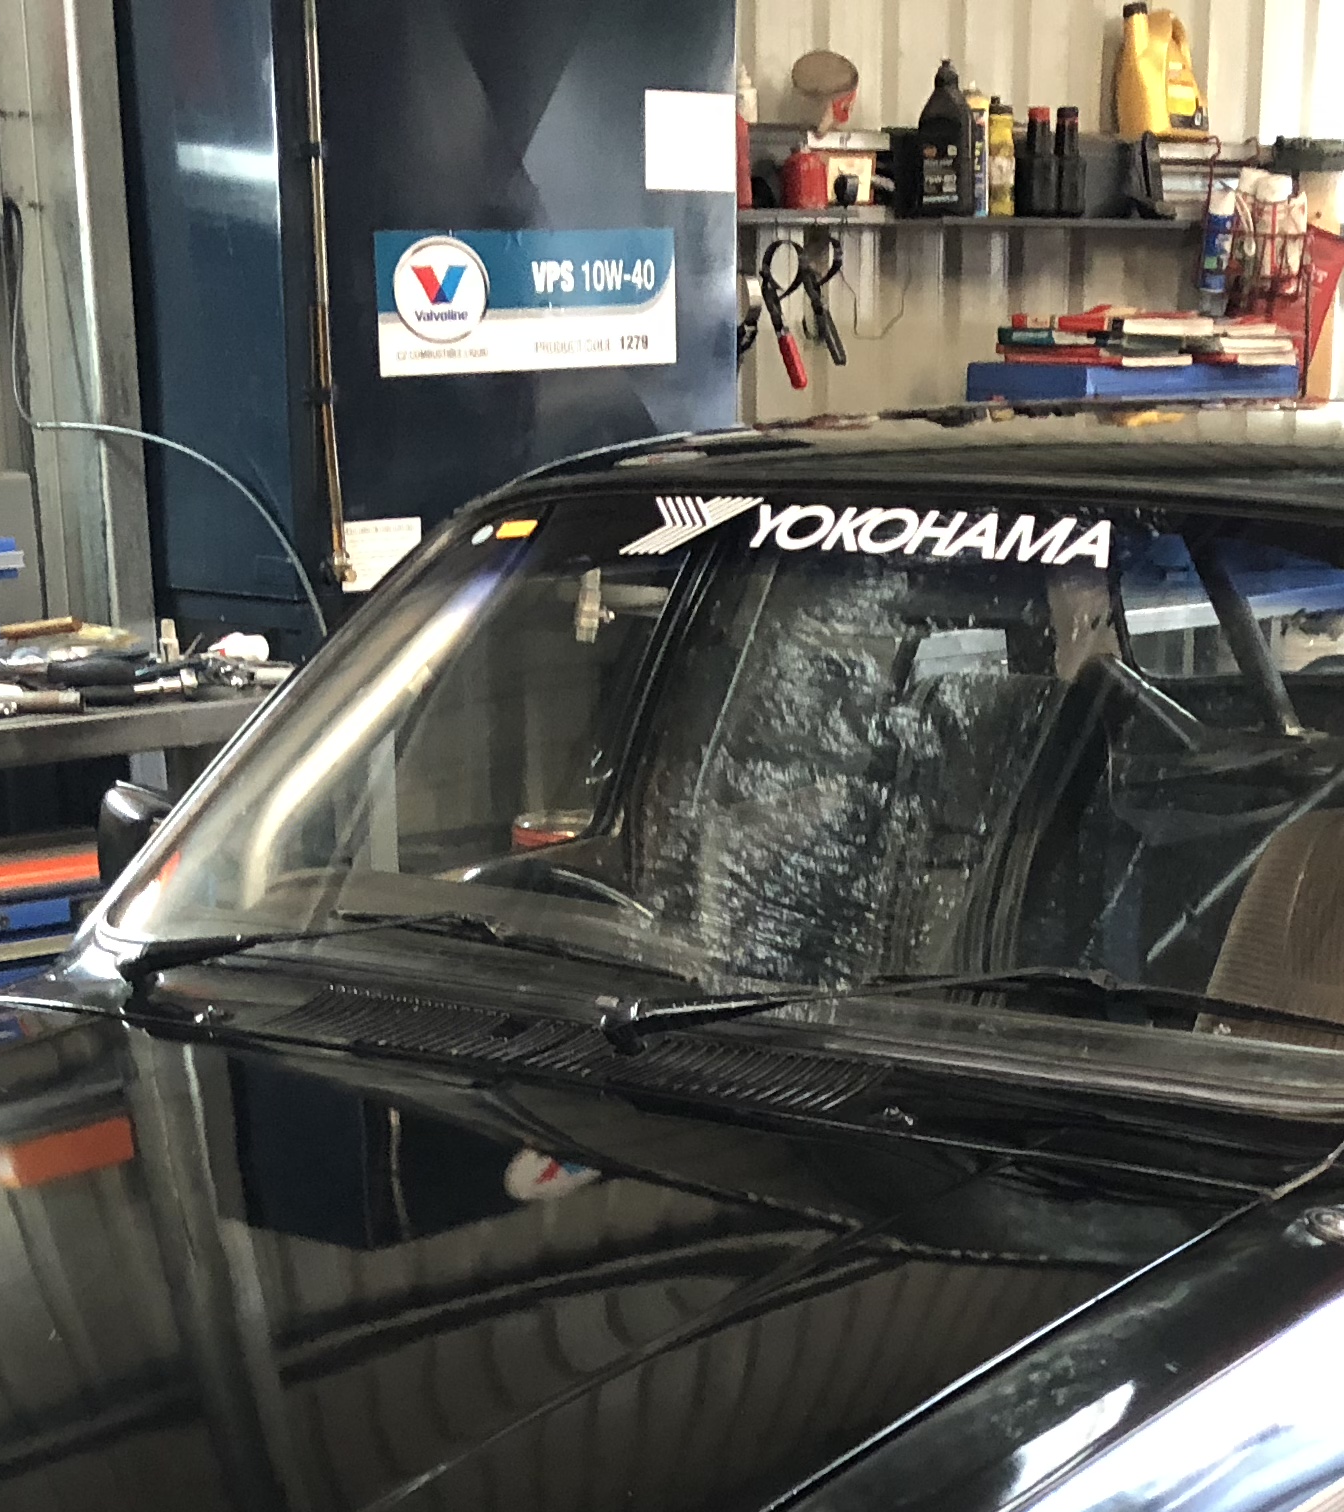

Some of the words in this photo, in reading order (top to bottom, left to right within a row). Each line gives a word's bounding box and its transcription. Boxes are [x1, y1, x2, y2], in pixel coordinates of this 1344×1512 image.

[532, 260, 575, 293] VPS
[581, 258, 655, 291] 10W-40
[415, 309, 468, 322] Valvoline
[749, 504, 1112, 569] YOKOHAMA
